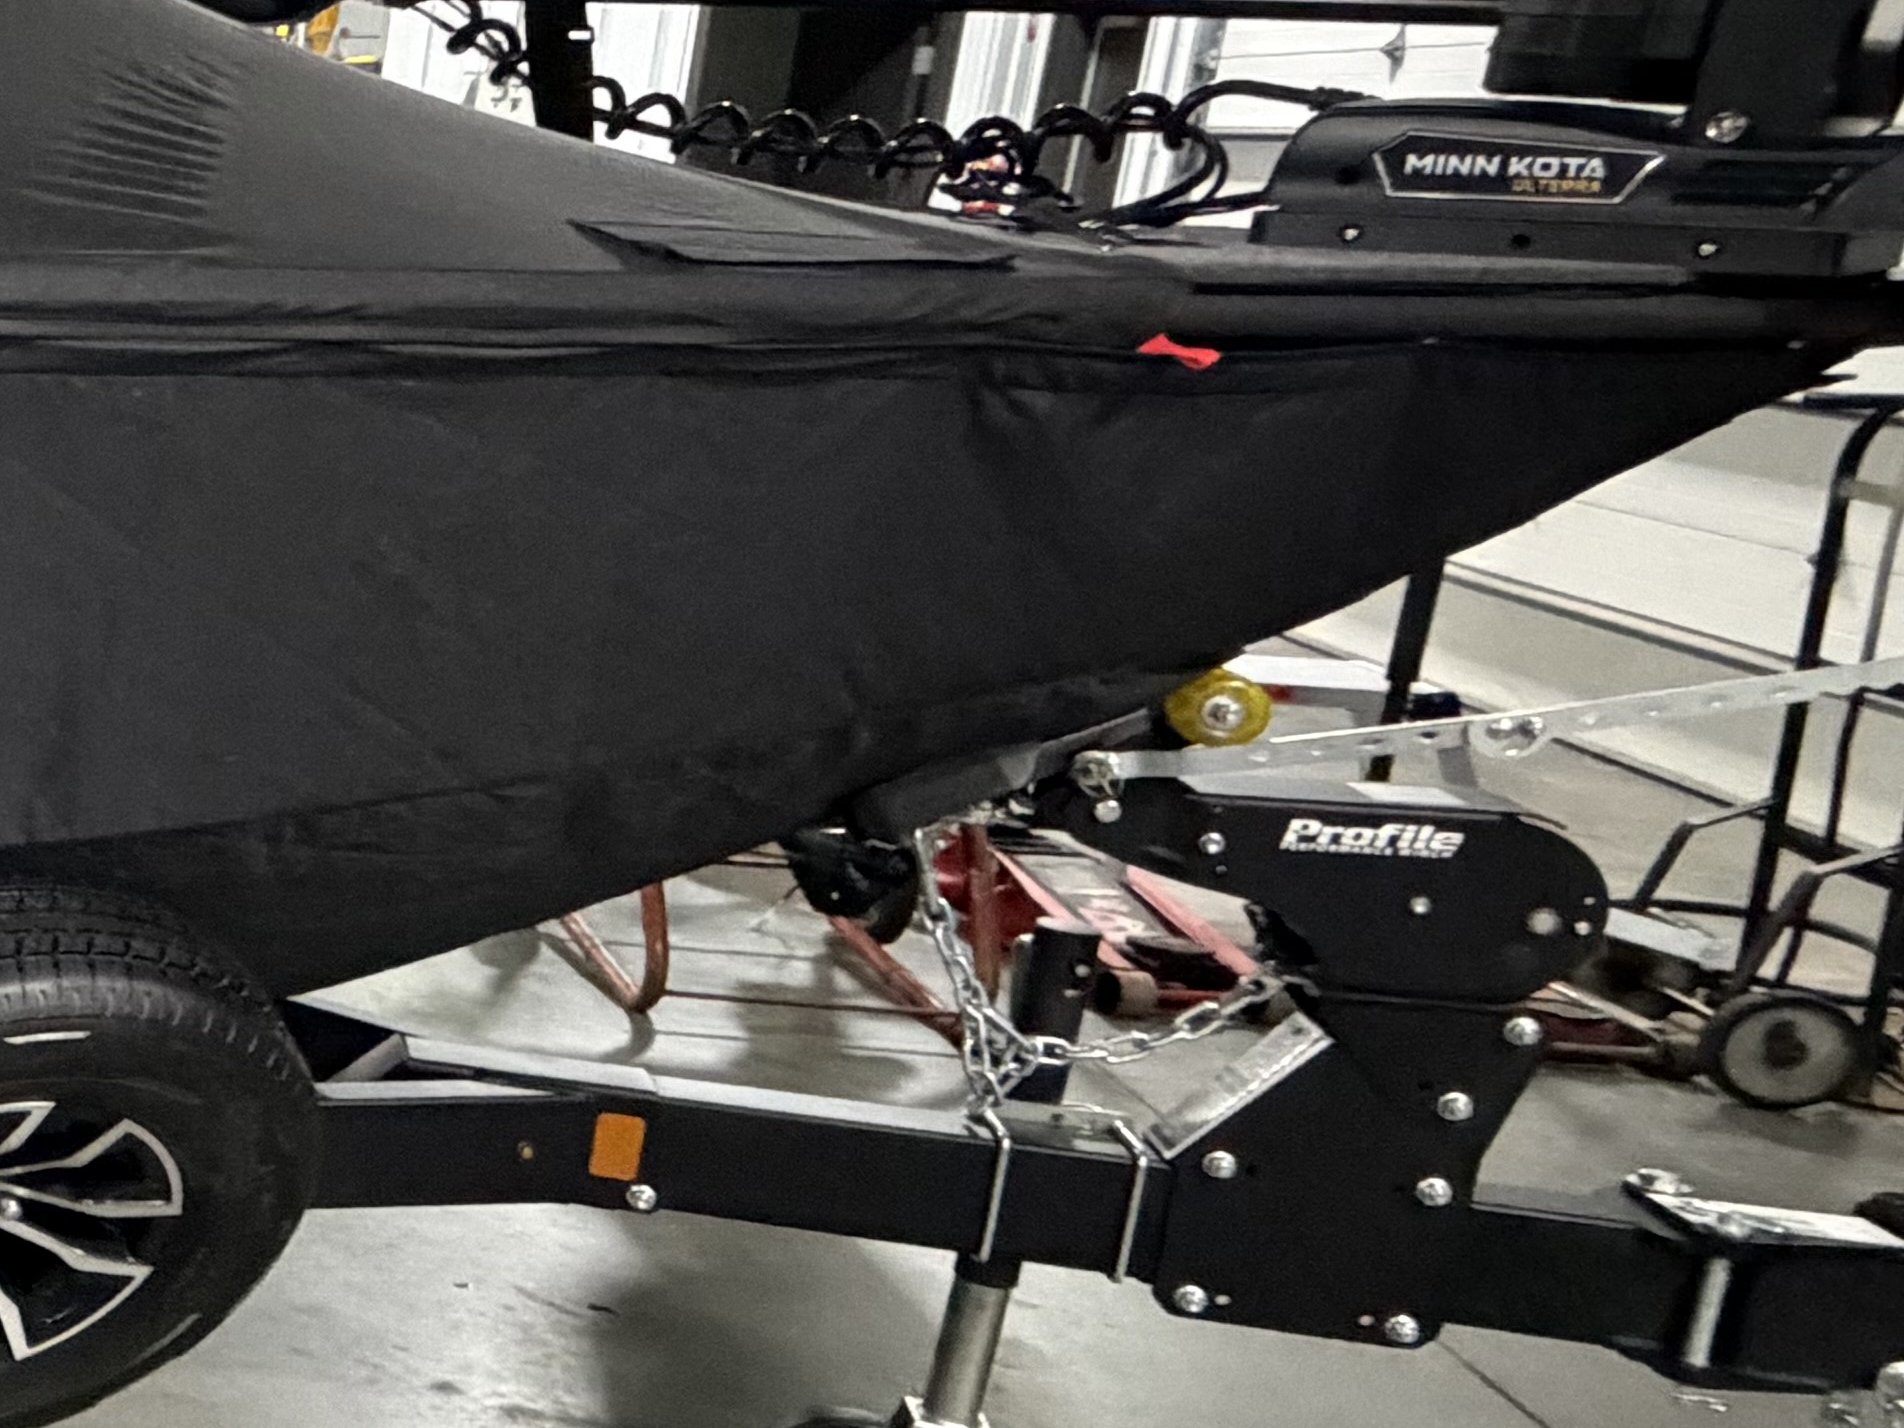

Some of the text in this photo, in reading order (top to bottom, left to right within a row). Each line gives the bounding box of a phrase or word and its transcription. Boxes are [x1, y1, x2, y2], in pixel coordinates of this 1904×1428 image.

[1403, 153, 1606, 179] MINN KOTA
[1279, 818, 1466, 851] Profile
